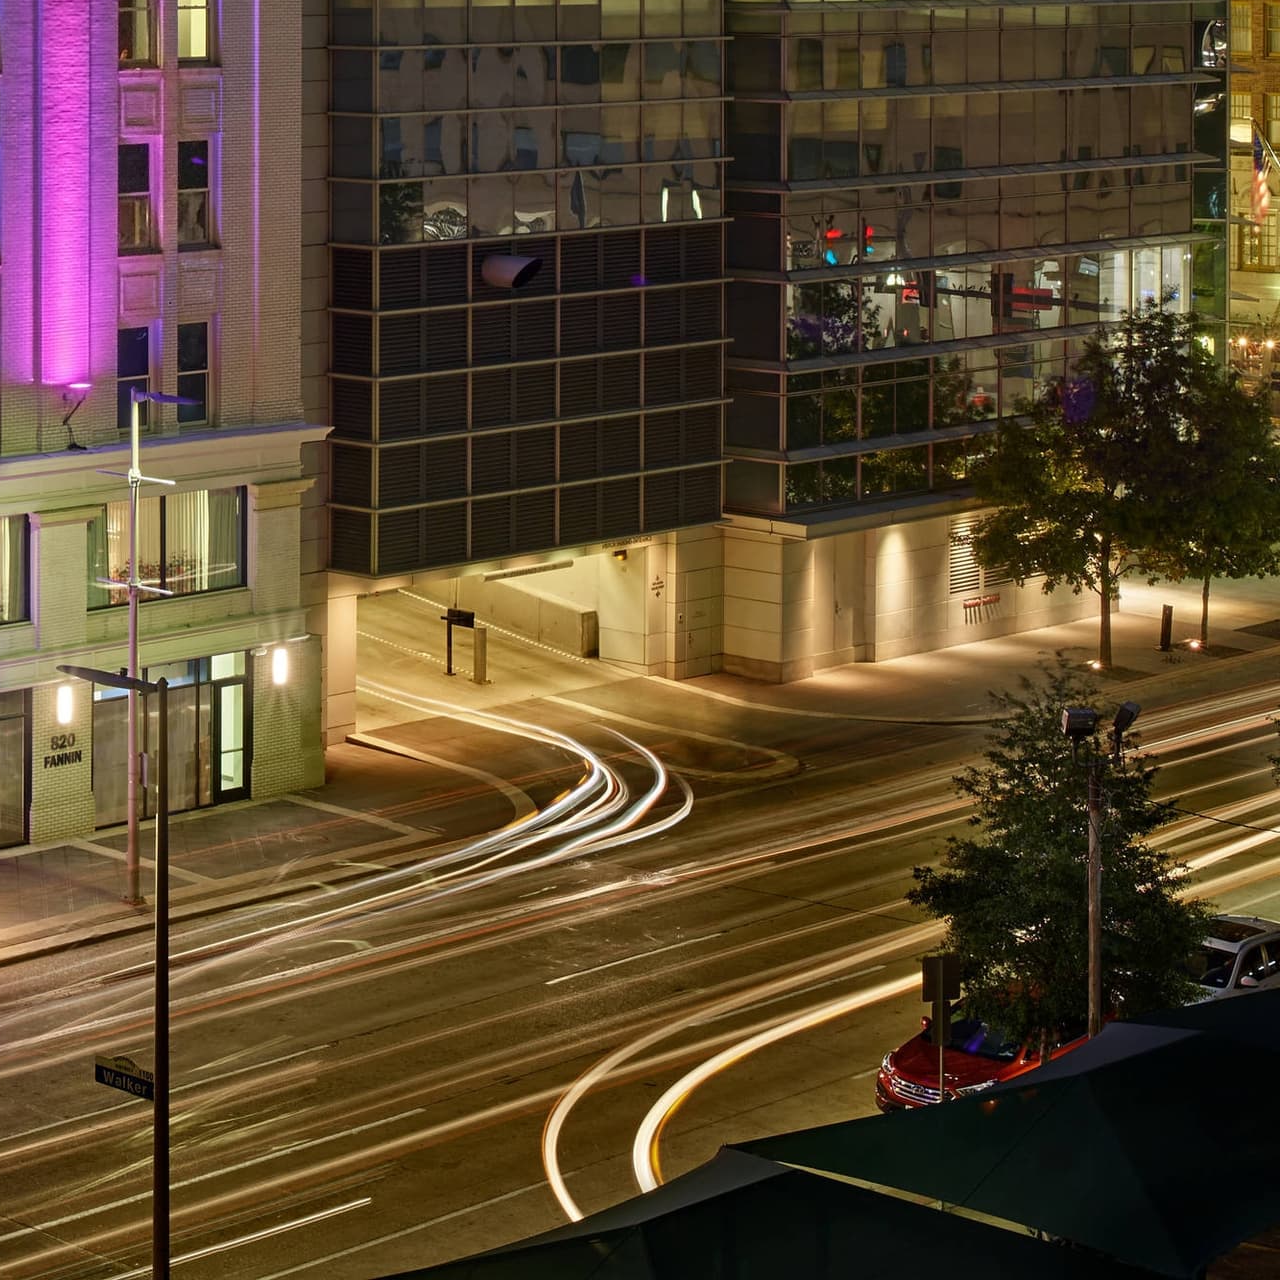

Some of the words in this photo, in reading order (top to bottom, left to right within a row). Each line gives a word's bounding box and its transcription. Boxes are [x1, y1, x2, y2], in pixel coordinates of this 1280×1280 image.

[50, 733, 76, 750] 820
[44, 750, 82, 769] FANNIN
[103, 1069, 148, 1096] Walker
